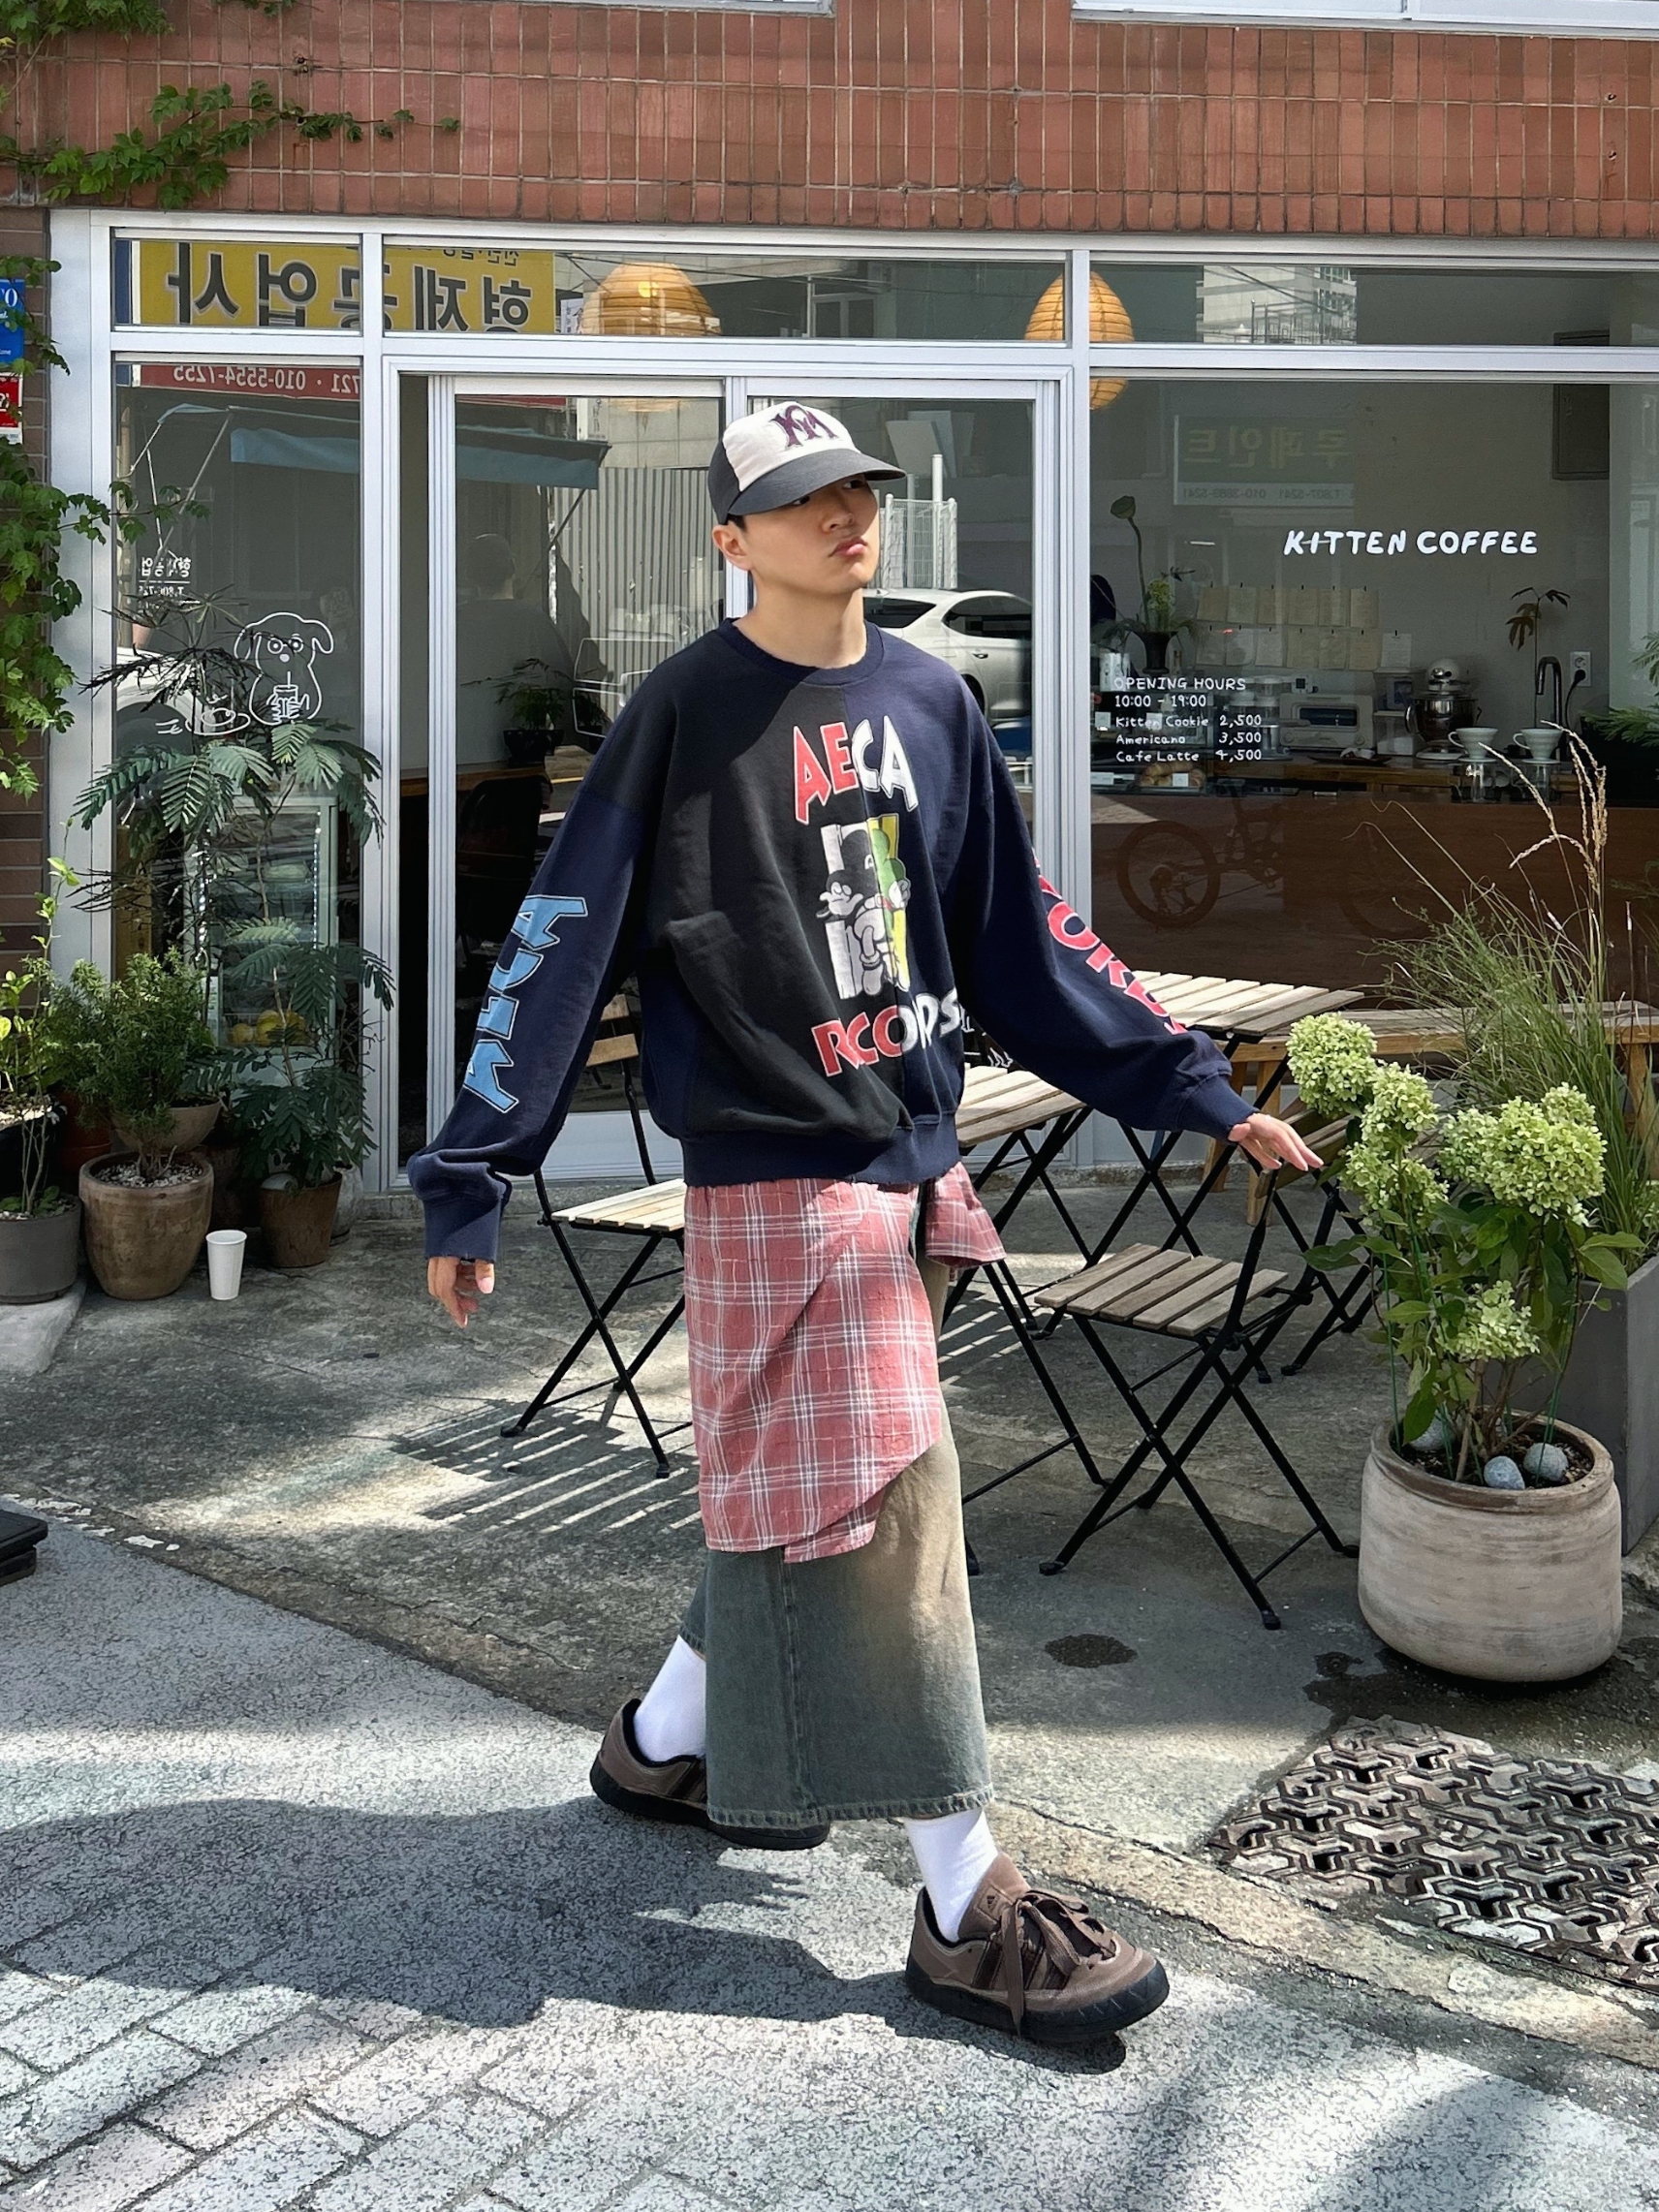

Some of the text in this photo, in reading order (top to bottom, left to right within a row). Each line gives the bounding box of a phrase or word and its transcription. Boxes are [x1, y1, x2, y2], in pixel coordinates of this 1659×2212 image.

[1284, 530, 1538, 555] KITTEN COFFEE
[1114, 677, 1246, 691] OPENING HOURS
[1115, 695, 1151, 707] 10:00
[1172, 695, 1206, 707] 19:00
[1115, 714, 1262, 729] Kitten Cookie 2,500
[1116, 732, 1262, 746] Americano 3,500
[1115, 749, 1262, 763] Cafe Latte 4,500
[793, 714, 920, 826] AECA
